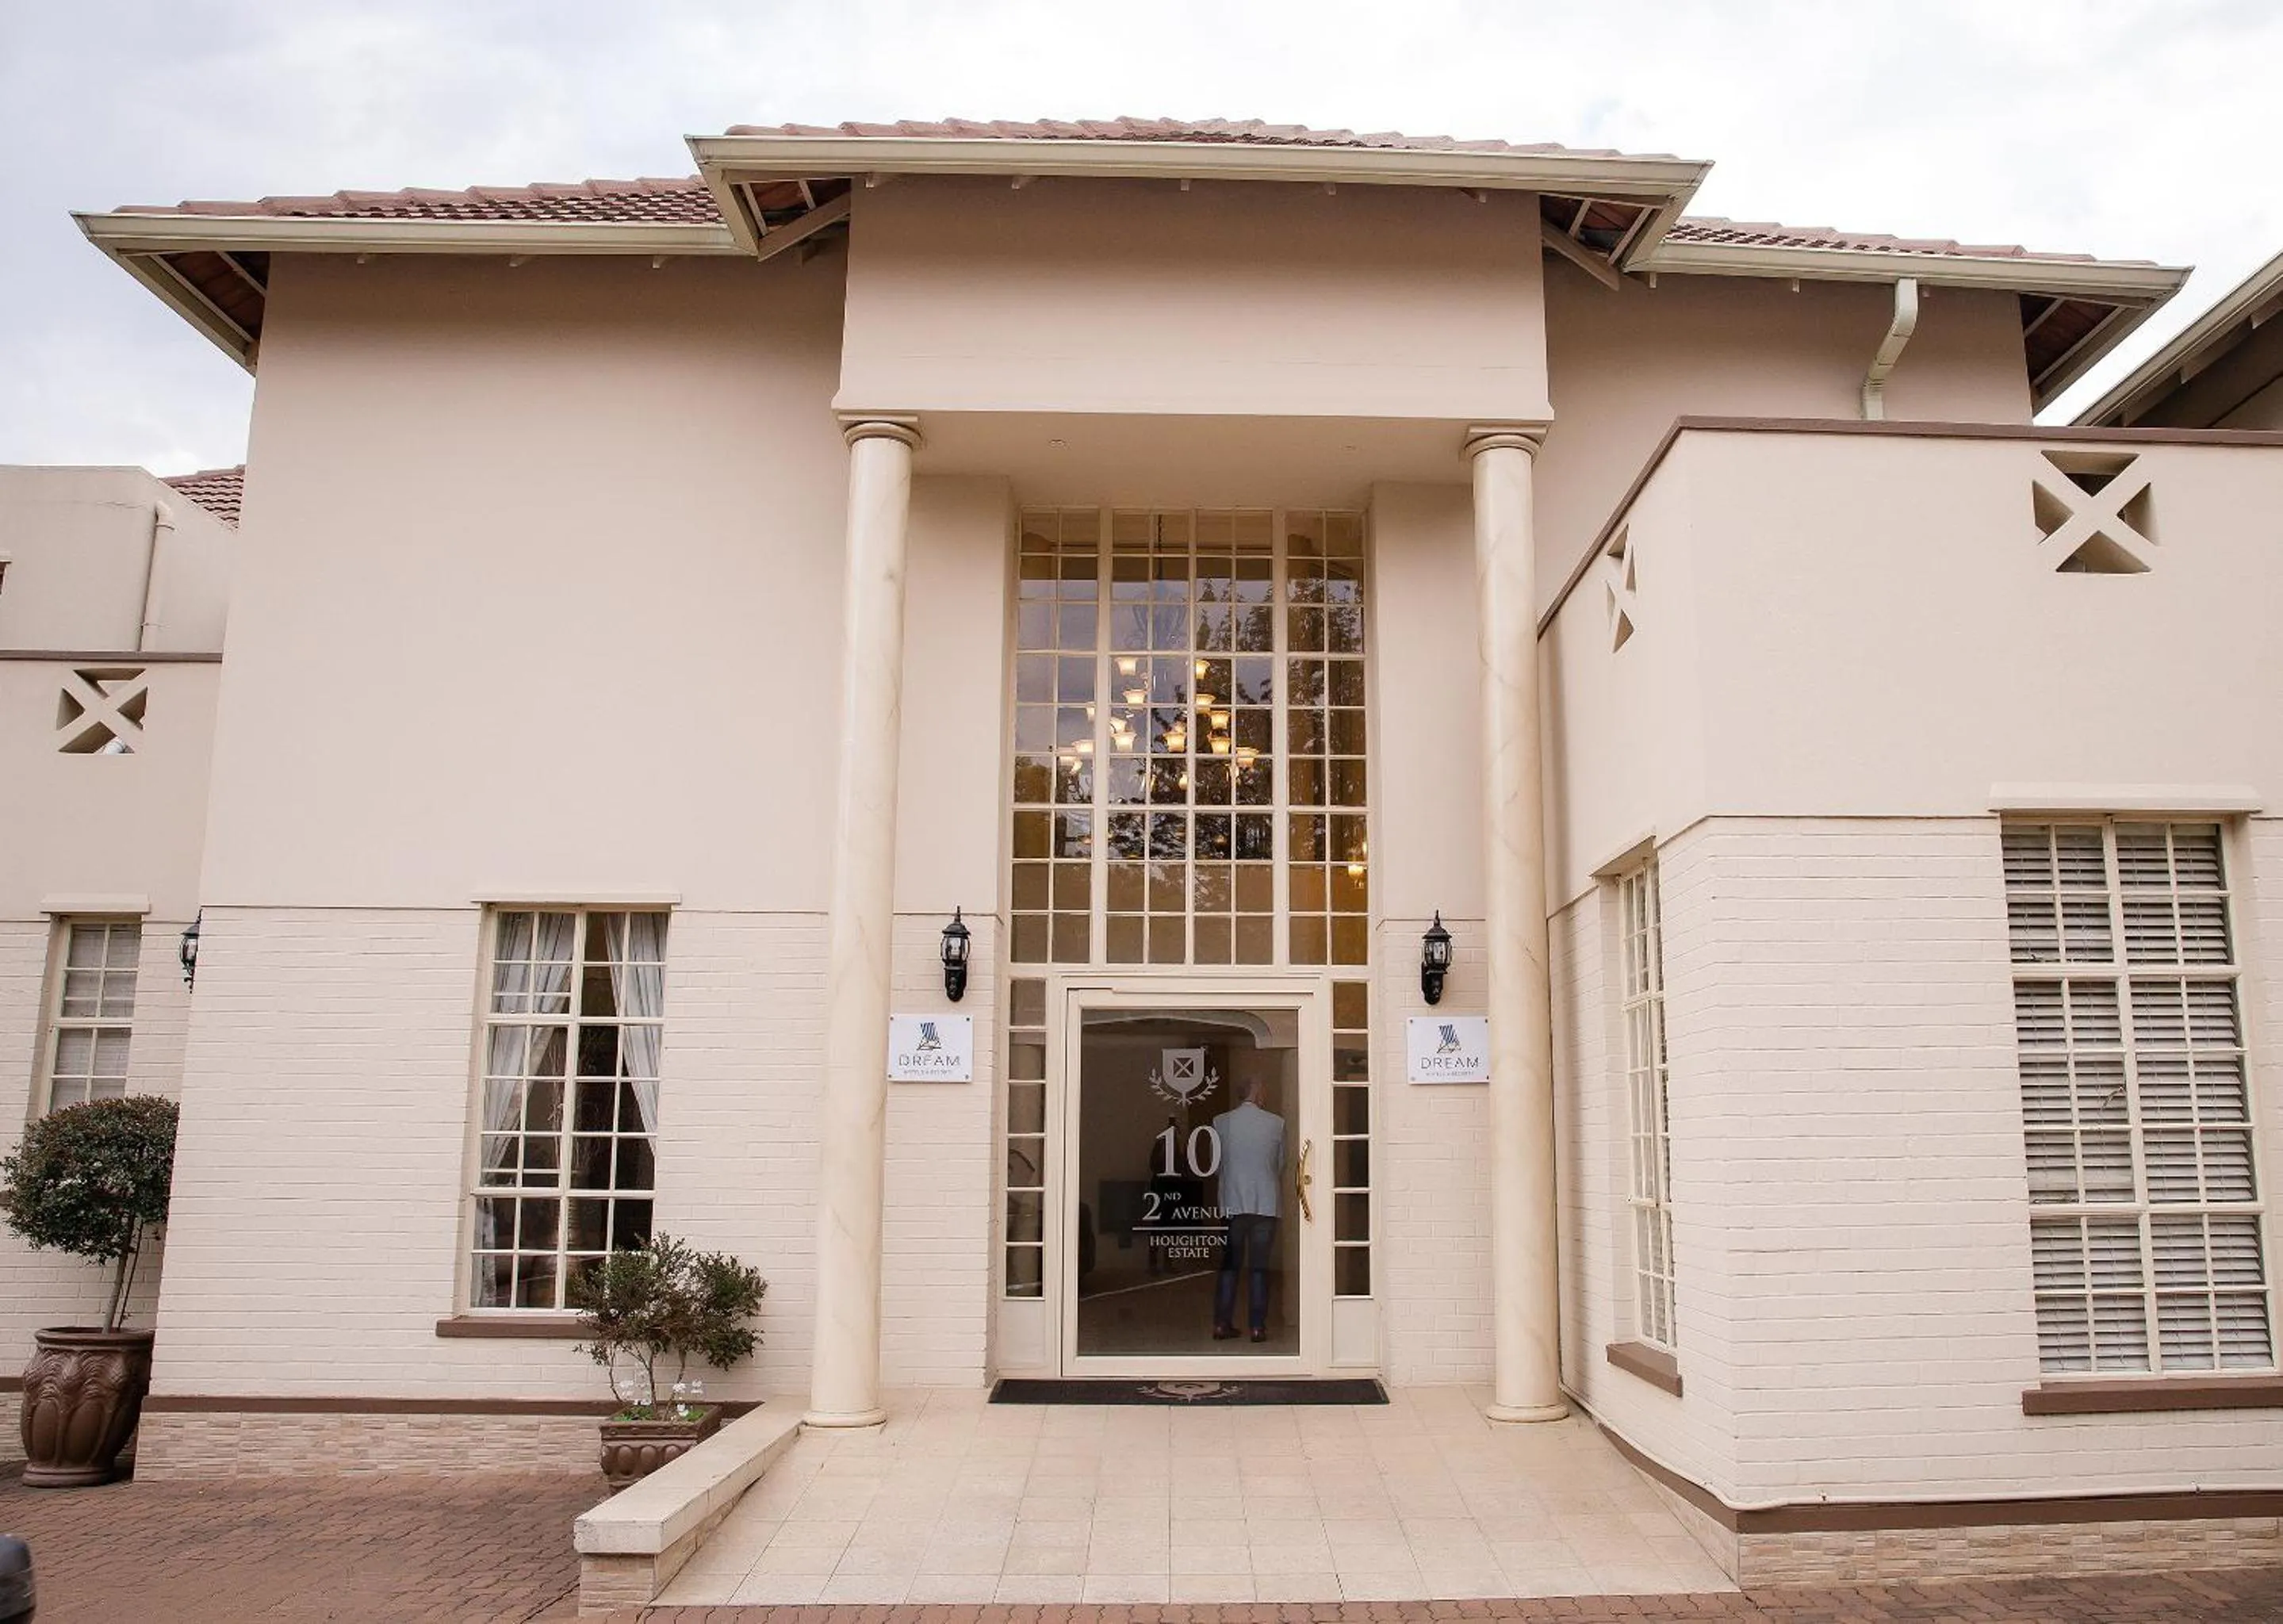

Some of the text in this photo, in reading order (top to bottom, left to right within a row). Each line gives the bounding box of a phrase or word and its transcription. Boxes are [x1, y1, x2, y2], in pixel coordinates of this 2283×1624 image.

[898, 1055, 960, 1066] DREAM
[1421, 1057, 1479, 1069] DREAM
[1155, 1125, 1221, 1178] 10
[1171, 1206, 1233, 1220] AVENUE
[1150, 1235, 1228, 1247] HOUGHTON
[1168, 1247, 1209, 1258] ESTATE
